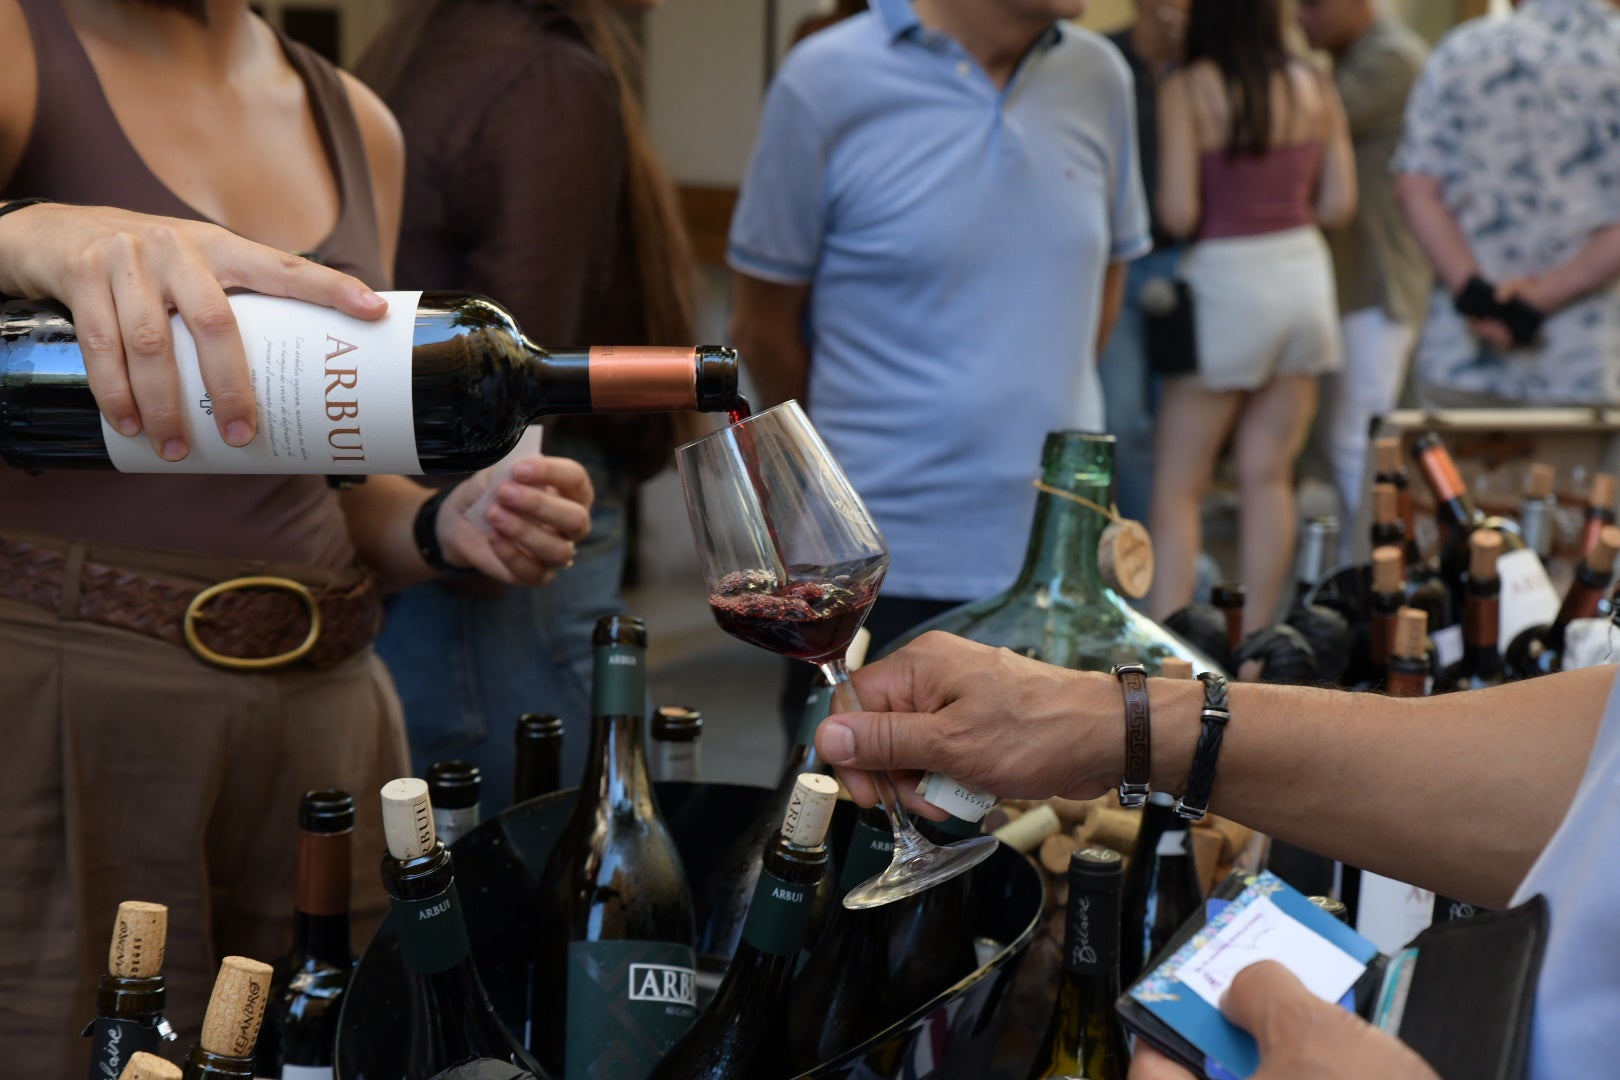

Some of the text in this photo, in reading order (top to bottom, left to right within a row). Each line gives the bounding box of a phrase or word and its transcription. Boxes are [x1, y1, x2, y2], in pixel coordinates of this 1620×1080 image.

[265, 376, 275, 409] momento
[325, 333, 366, 462] ARBUI
[416, 807, 431, 854] BUI
[783, 793, 802, 842] ARB
[871, 839, 894, 851] ARB
[419, 899, 451, 920] ARBUI
[772, 887, 803, 903] ARBUI
[114, 920, 129, 972] ANDRO
[130, 937, 143, 978] DEGAS
[639, 969, 696, 1003] ARB
[232, 977, 261, 1056] LEJANDRO
[98, 1025, 123, 1080] laire
